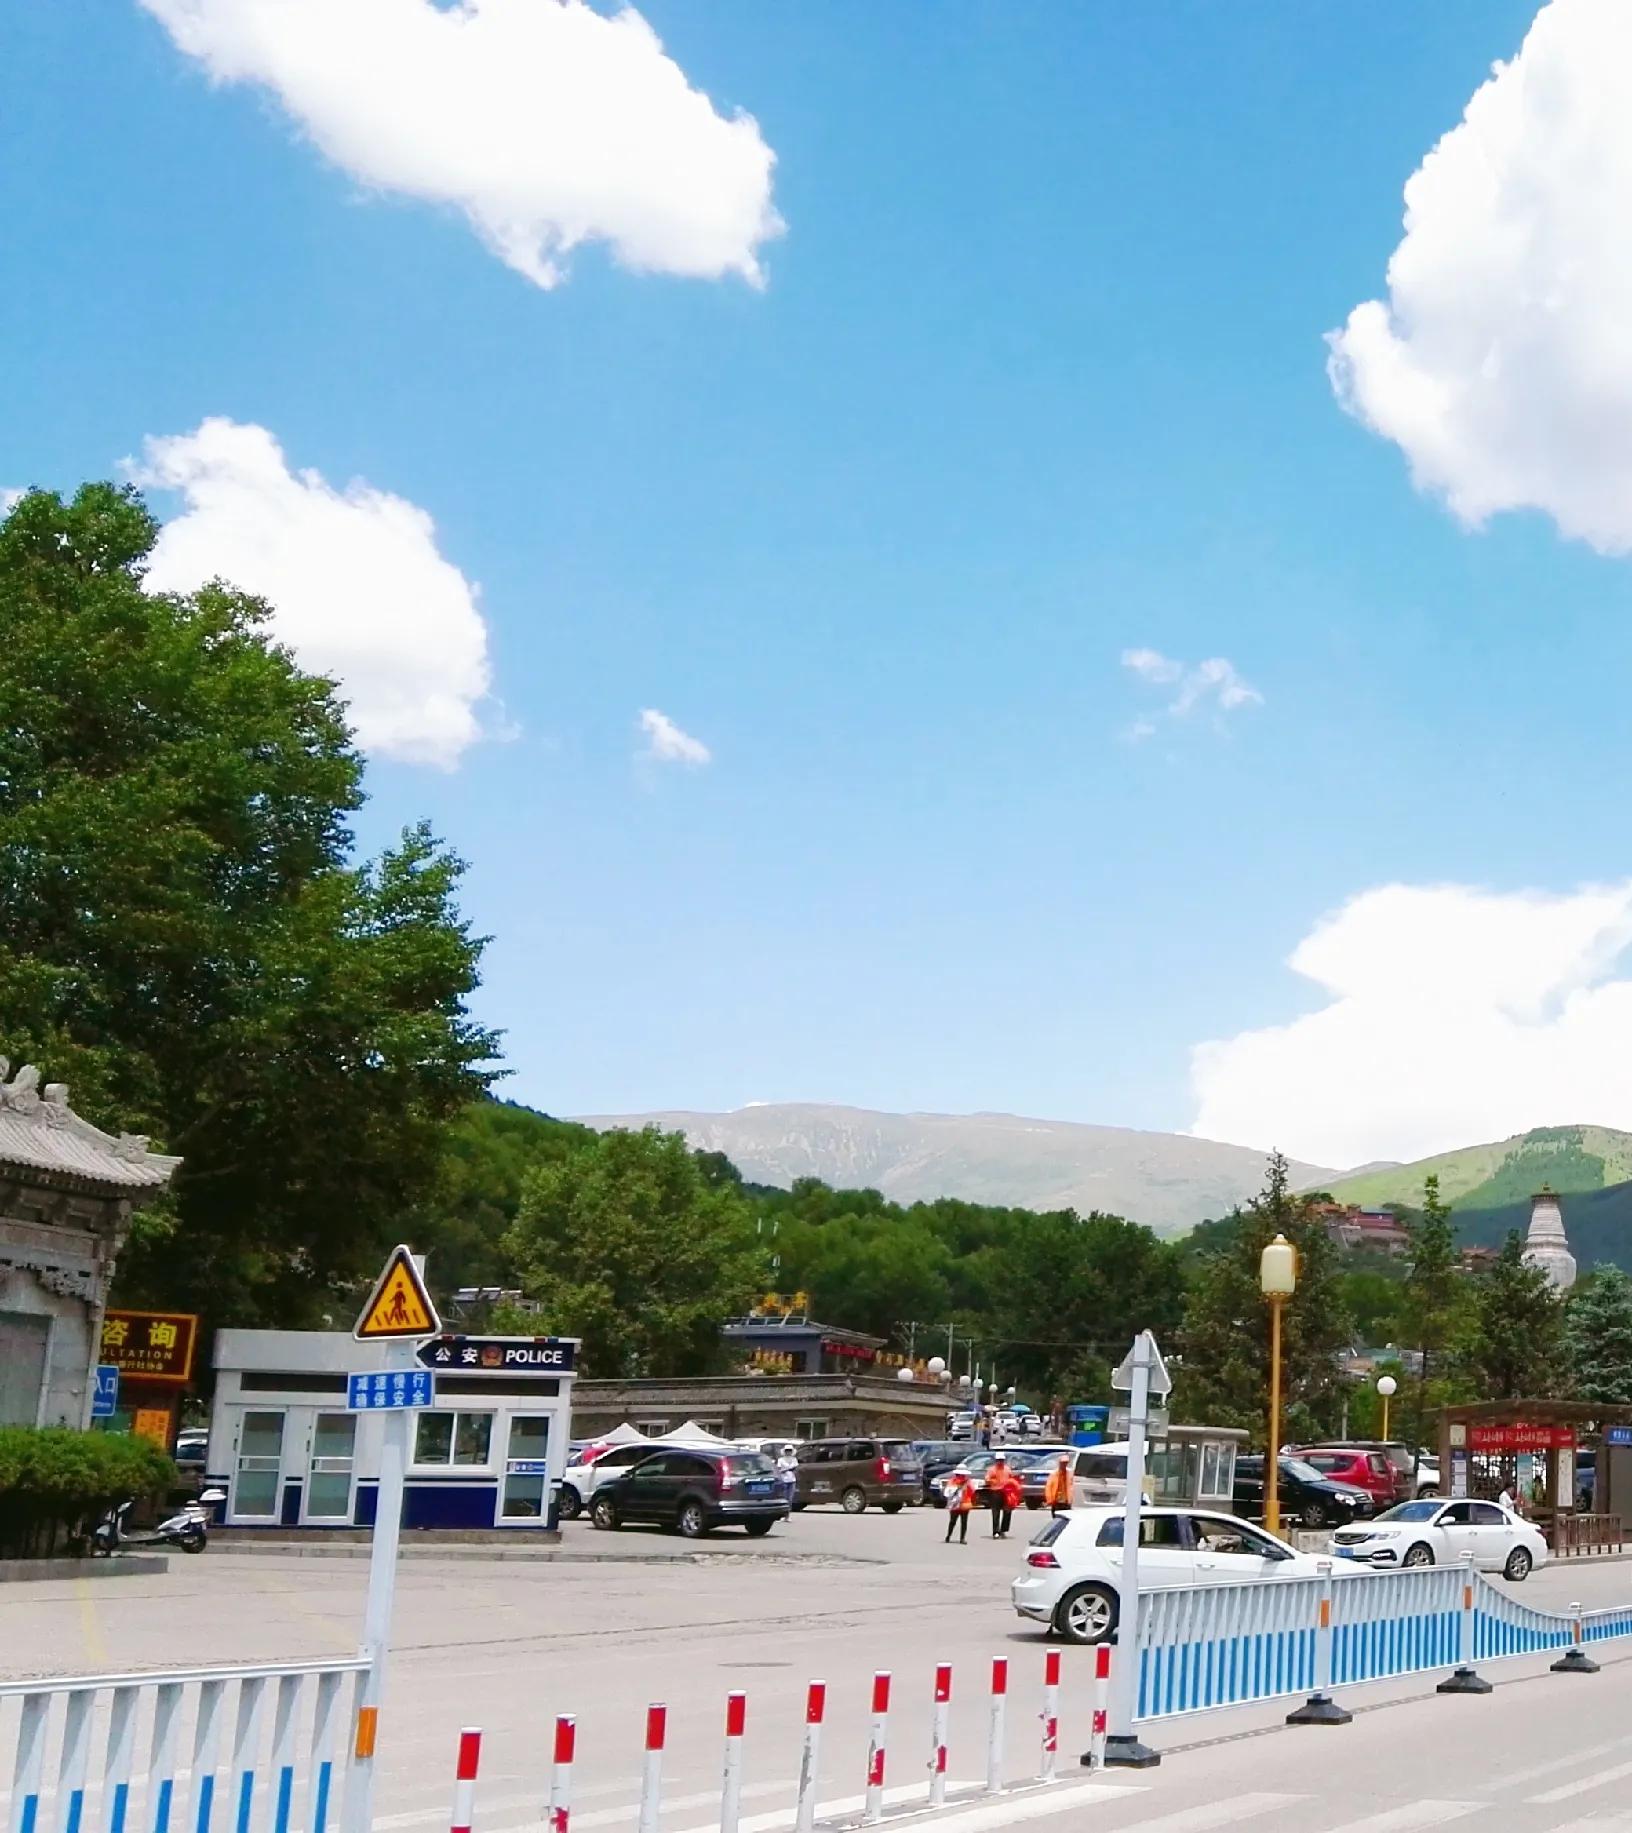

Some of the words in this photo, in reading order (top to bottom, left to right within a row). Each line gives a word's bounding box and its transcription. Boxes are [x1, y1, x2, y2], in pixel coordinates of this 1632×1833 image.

[103, 1319, 178, 1348] 咨询
[435, 1347, 479, 1363] 公安
[505, 1349, 563, 1364] POLICE
[356, 1373, 425, 1391] 减速慢行
[355, 1390, 425, 1407] 确保安全
